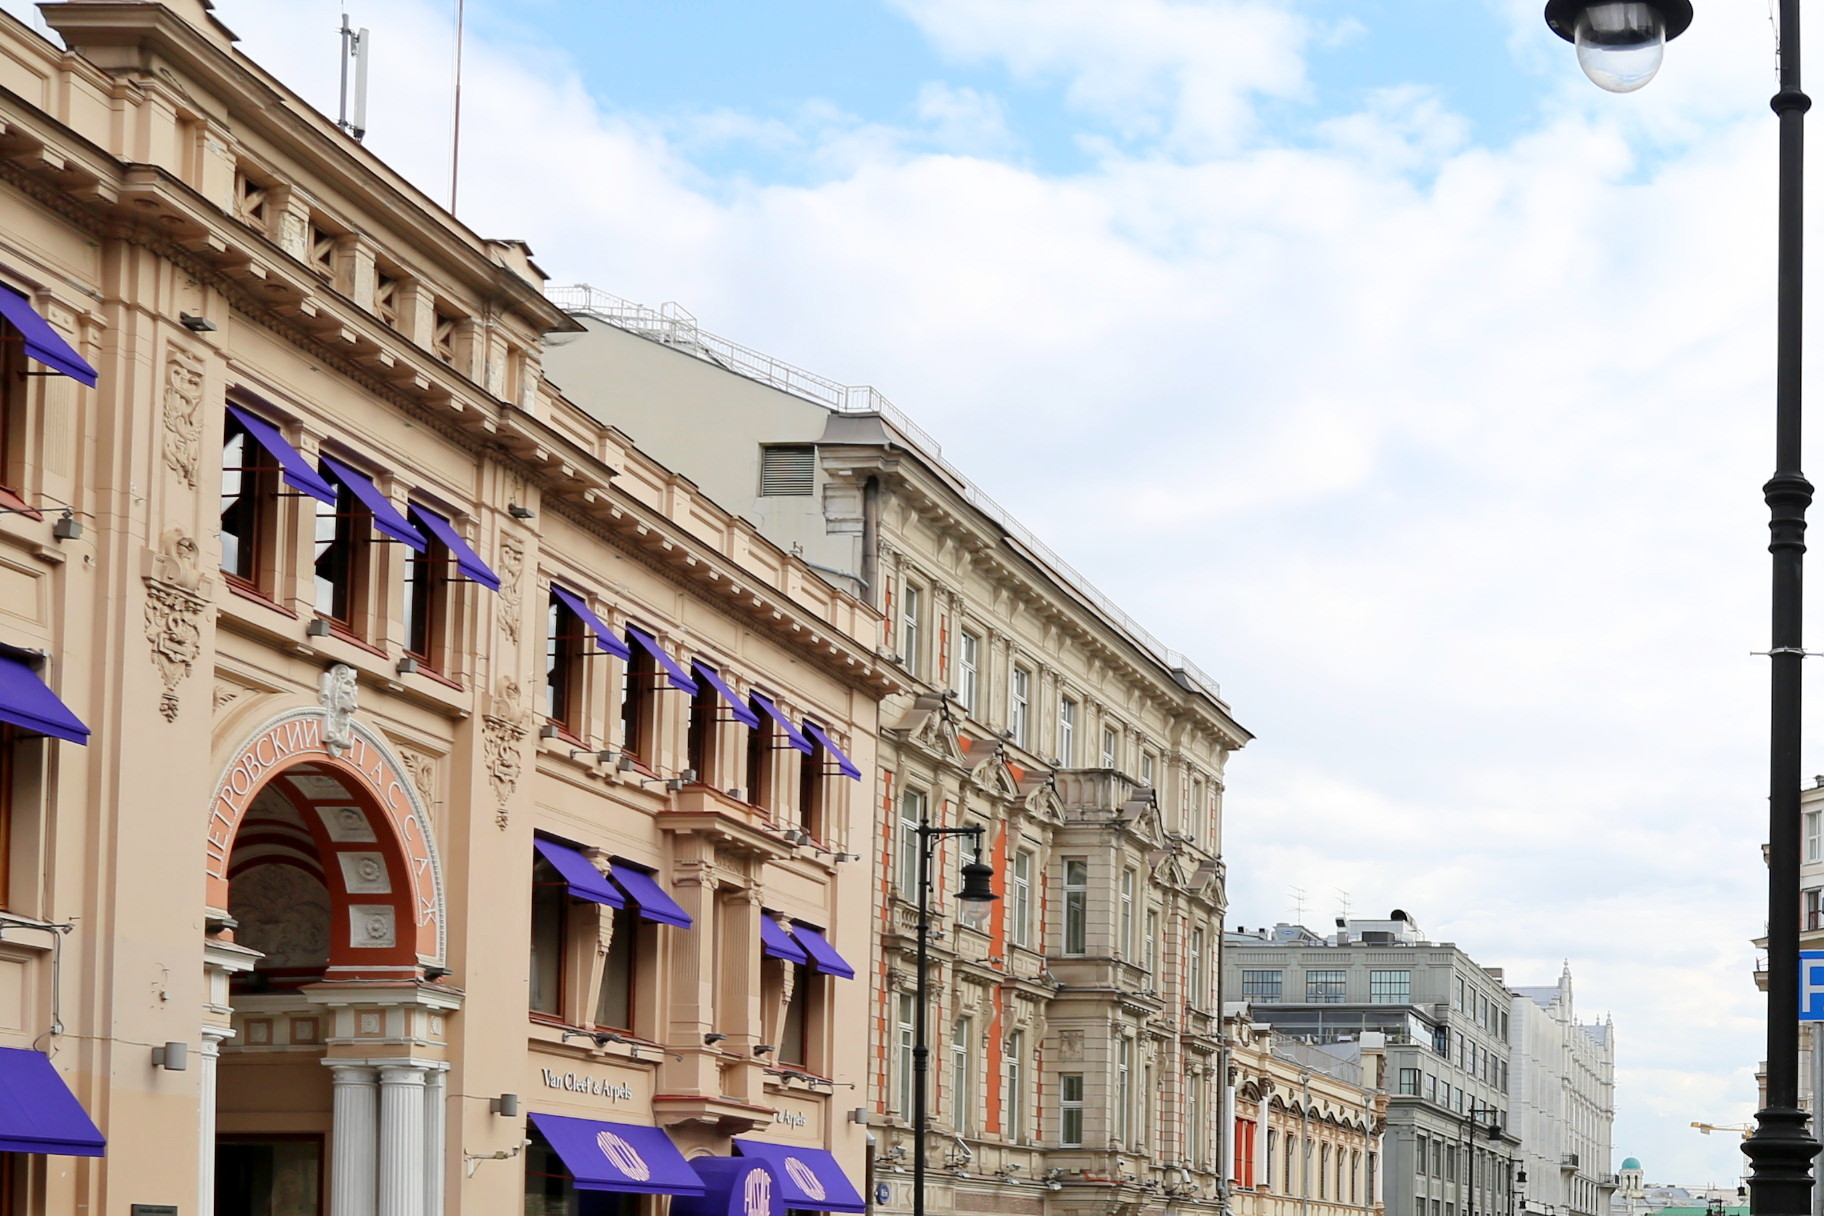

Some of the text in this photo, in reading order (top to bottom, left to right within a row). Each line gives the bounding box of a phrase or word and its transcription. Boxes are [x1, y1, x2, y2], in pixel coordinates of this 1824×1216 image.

[349, 735, 438, 927] ПАССАЖ
[542, 1068, 632, 1104] Van Cleef & Arpels
